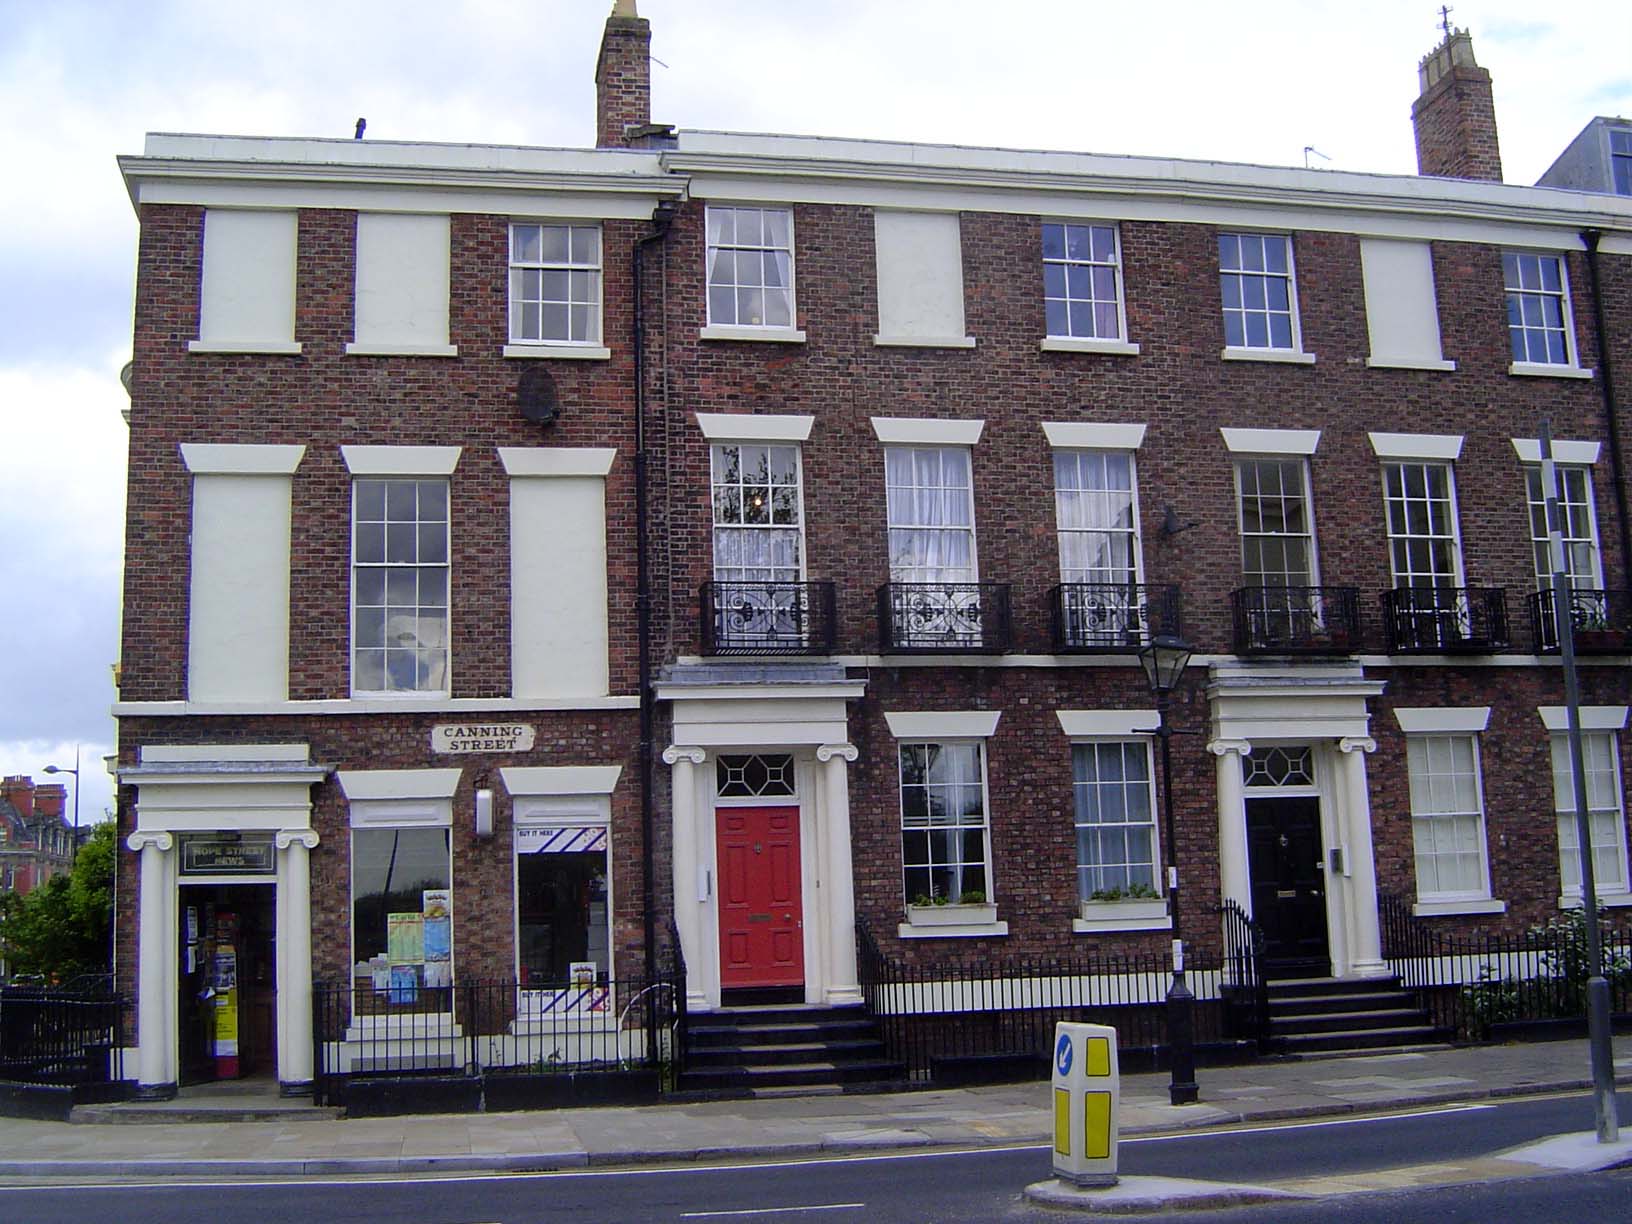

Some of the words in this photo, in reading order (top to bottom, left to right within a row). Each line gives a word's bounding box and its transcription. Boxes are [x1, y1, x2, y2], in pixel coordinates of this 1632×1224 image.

[444, 726, 522, 737] CANNING
[450, 740, 516, 750] STREET
[192, 847, 222, 855] HOPE
[224, 847, 266, 855] STREET
